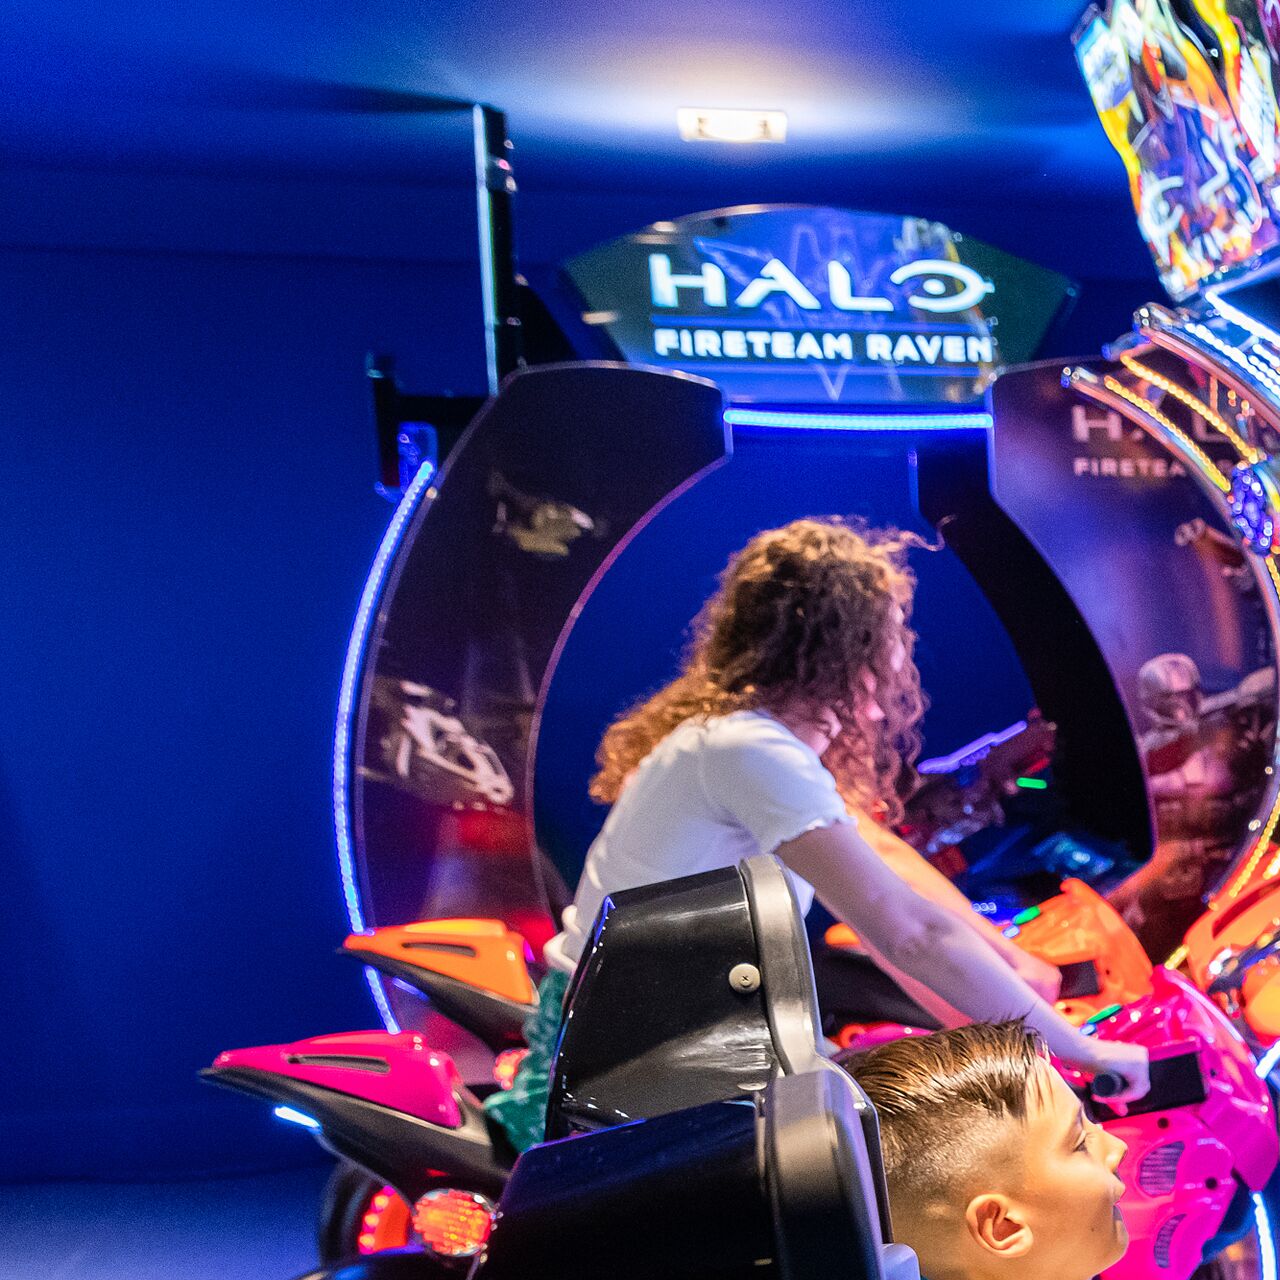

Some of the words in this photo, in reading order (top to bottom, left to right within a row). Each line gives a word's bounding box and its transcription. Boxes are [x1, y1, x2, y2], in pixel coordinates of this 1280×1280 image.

[649, 253, 996, 313] HALO
[654, 328, 853, 360] FIRETEAM
[866, 334, 994, 363] RAVEN
